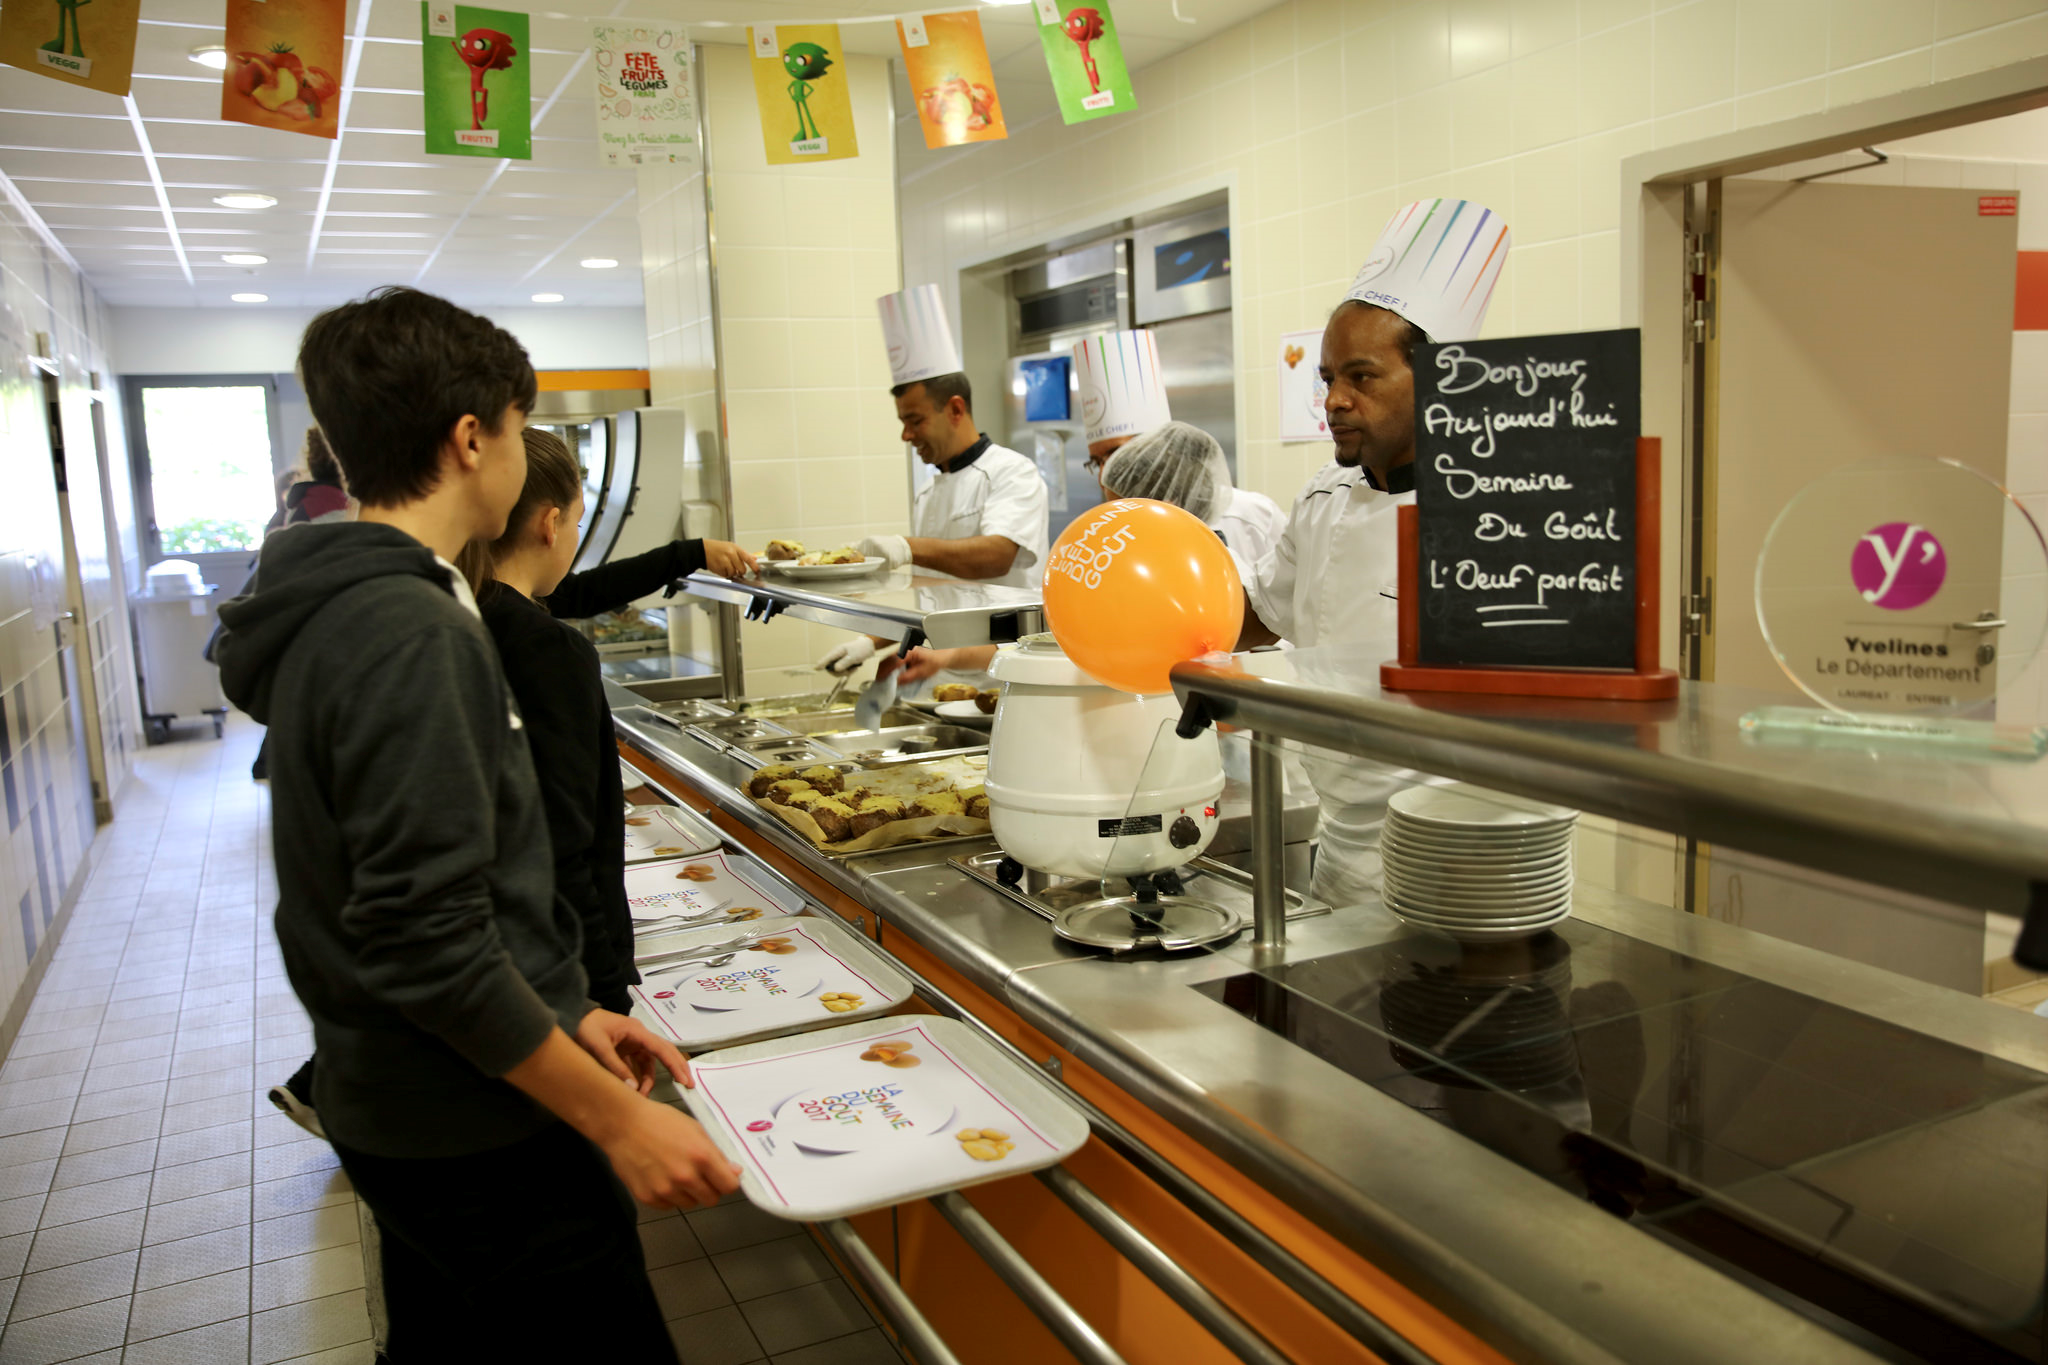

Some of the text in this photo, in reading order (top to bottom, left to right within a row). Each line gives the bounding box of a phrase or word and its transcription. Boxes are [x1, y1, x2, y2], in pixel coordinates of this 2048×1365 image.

[48, 54, 80, 71] VEGGI
[621, 69, 665, 82] FRUITS
[461, 134, 494, 144] FRUTTI
[797, 143, 821, 151] VEGGI
[1364, 290, 1400, 305] CHEF
[1105, 424, 1129, 434] CHEF
[1424, 390, 1618, 458] Aujourd'hui
[1434, 453, 1573, 499] Semaine
[1474, 507, 1622, 542] Du Goût
[1060, 501, 1145, 576] SEMAINE
[1070, 546, 1096, 583] DU
[1537, 562, 1623, 605] parfait
[1845, 636, 1949, 658] Yvelines
[1815, 657, 1981, 683] Le Département
[731, 971, 752, 981] DU
[763, 965, 781, 974] LA
[696, 977, 722, 992] 2017
[747, 968, 788, 996] SEMAINE
[841, 1090, 868, 1106] DU
[880, 1082, 904, 1097] LA
[798, 1099, 832, 1121] 2017
[821, 1095, 862, 1125] GOÛT
[861, 1087, 914, 1130] SEMAINE
